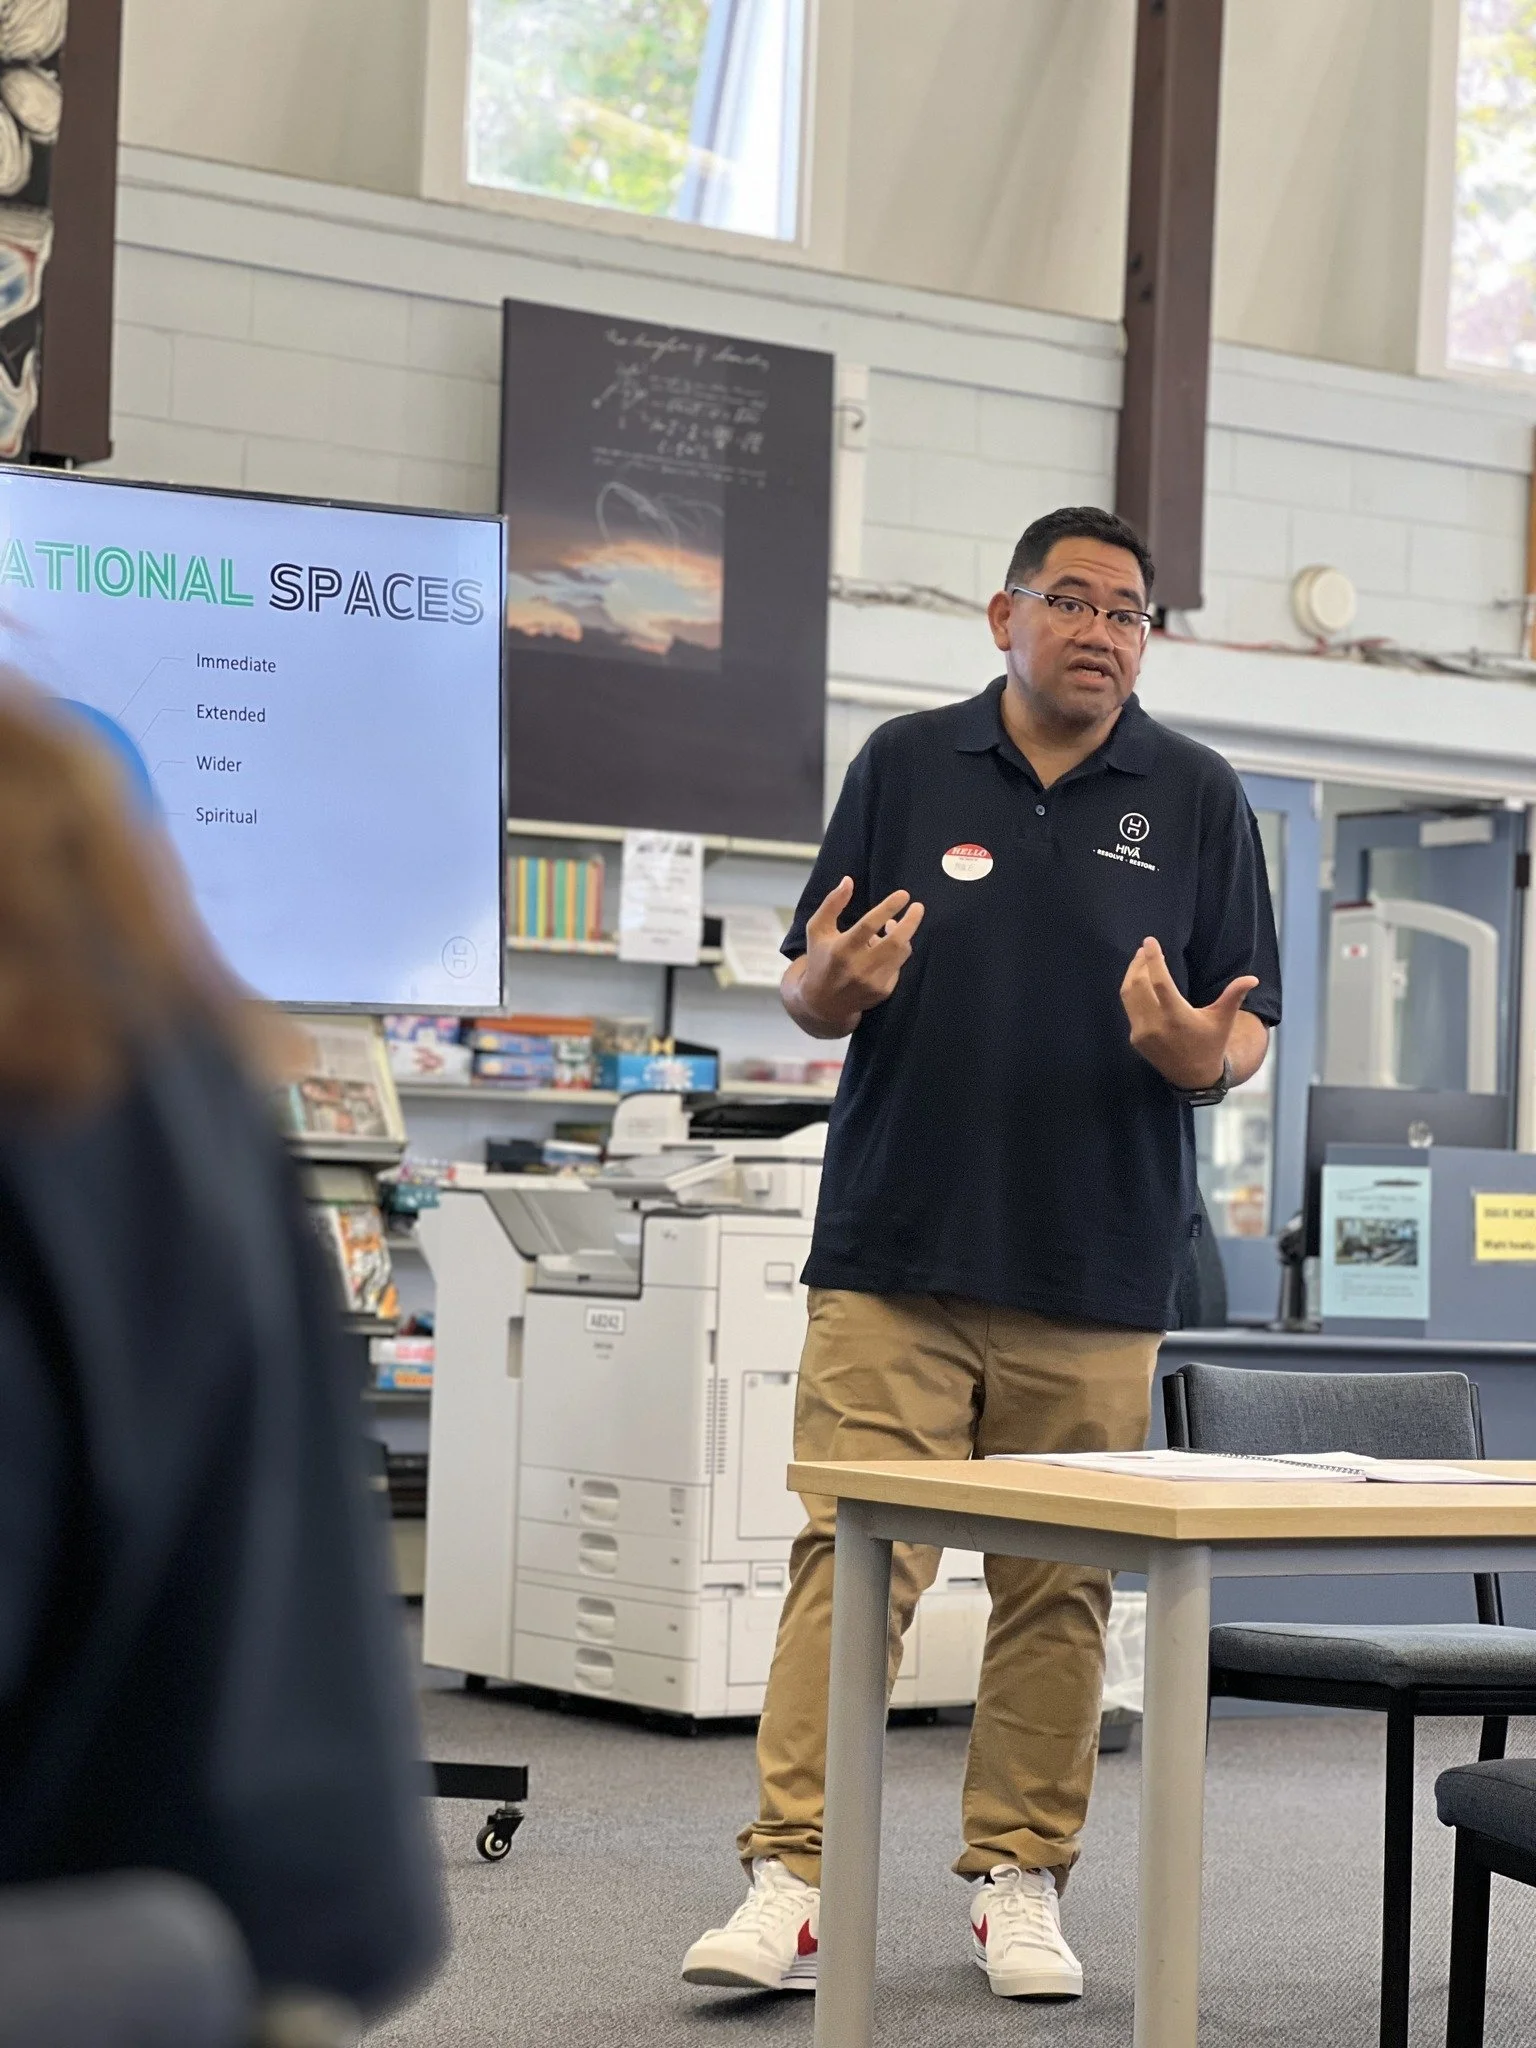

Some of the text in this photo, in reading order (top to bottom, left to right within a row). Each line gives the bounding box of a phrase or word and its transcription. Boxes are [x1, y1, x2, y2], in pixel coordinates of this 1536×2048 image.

[269, 562, 485, 626] SPACES
[196, 653, 276, 673] Immediate
[196, 704, 266, 723] Extended
[196, 755, 242, 773] Wider
[196, 806, 258, 825] Spiritual
[951, 846, 988, 857] HELLO
[1096, 848, 1156, 871] RESOLVE RESTORE
[1115, 843, 1141, 859] HIVĀ
